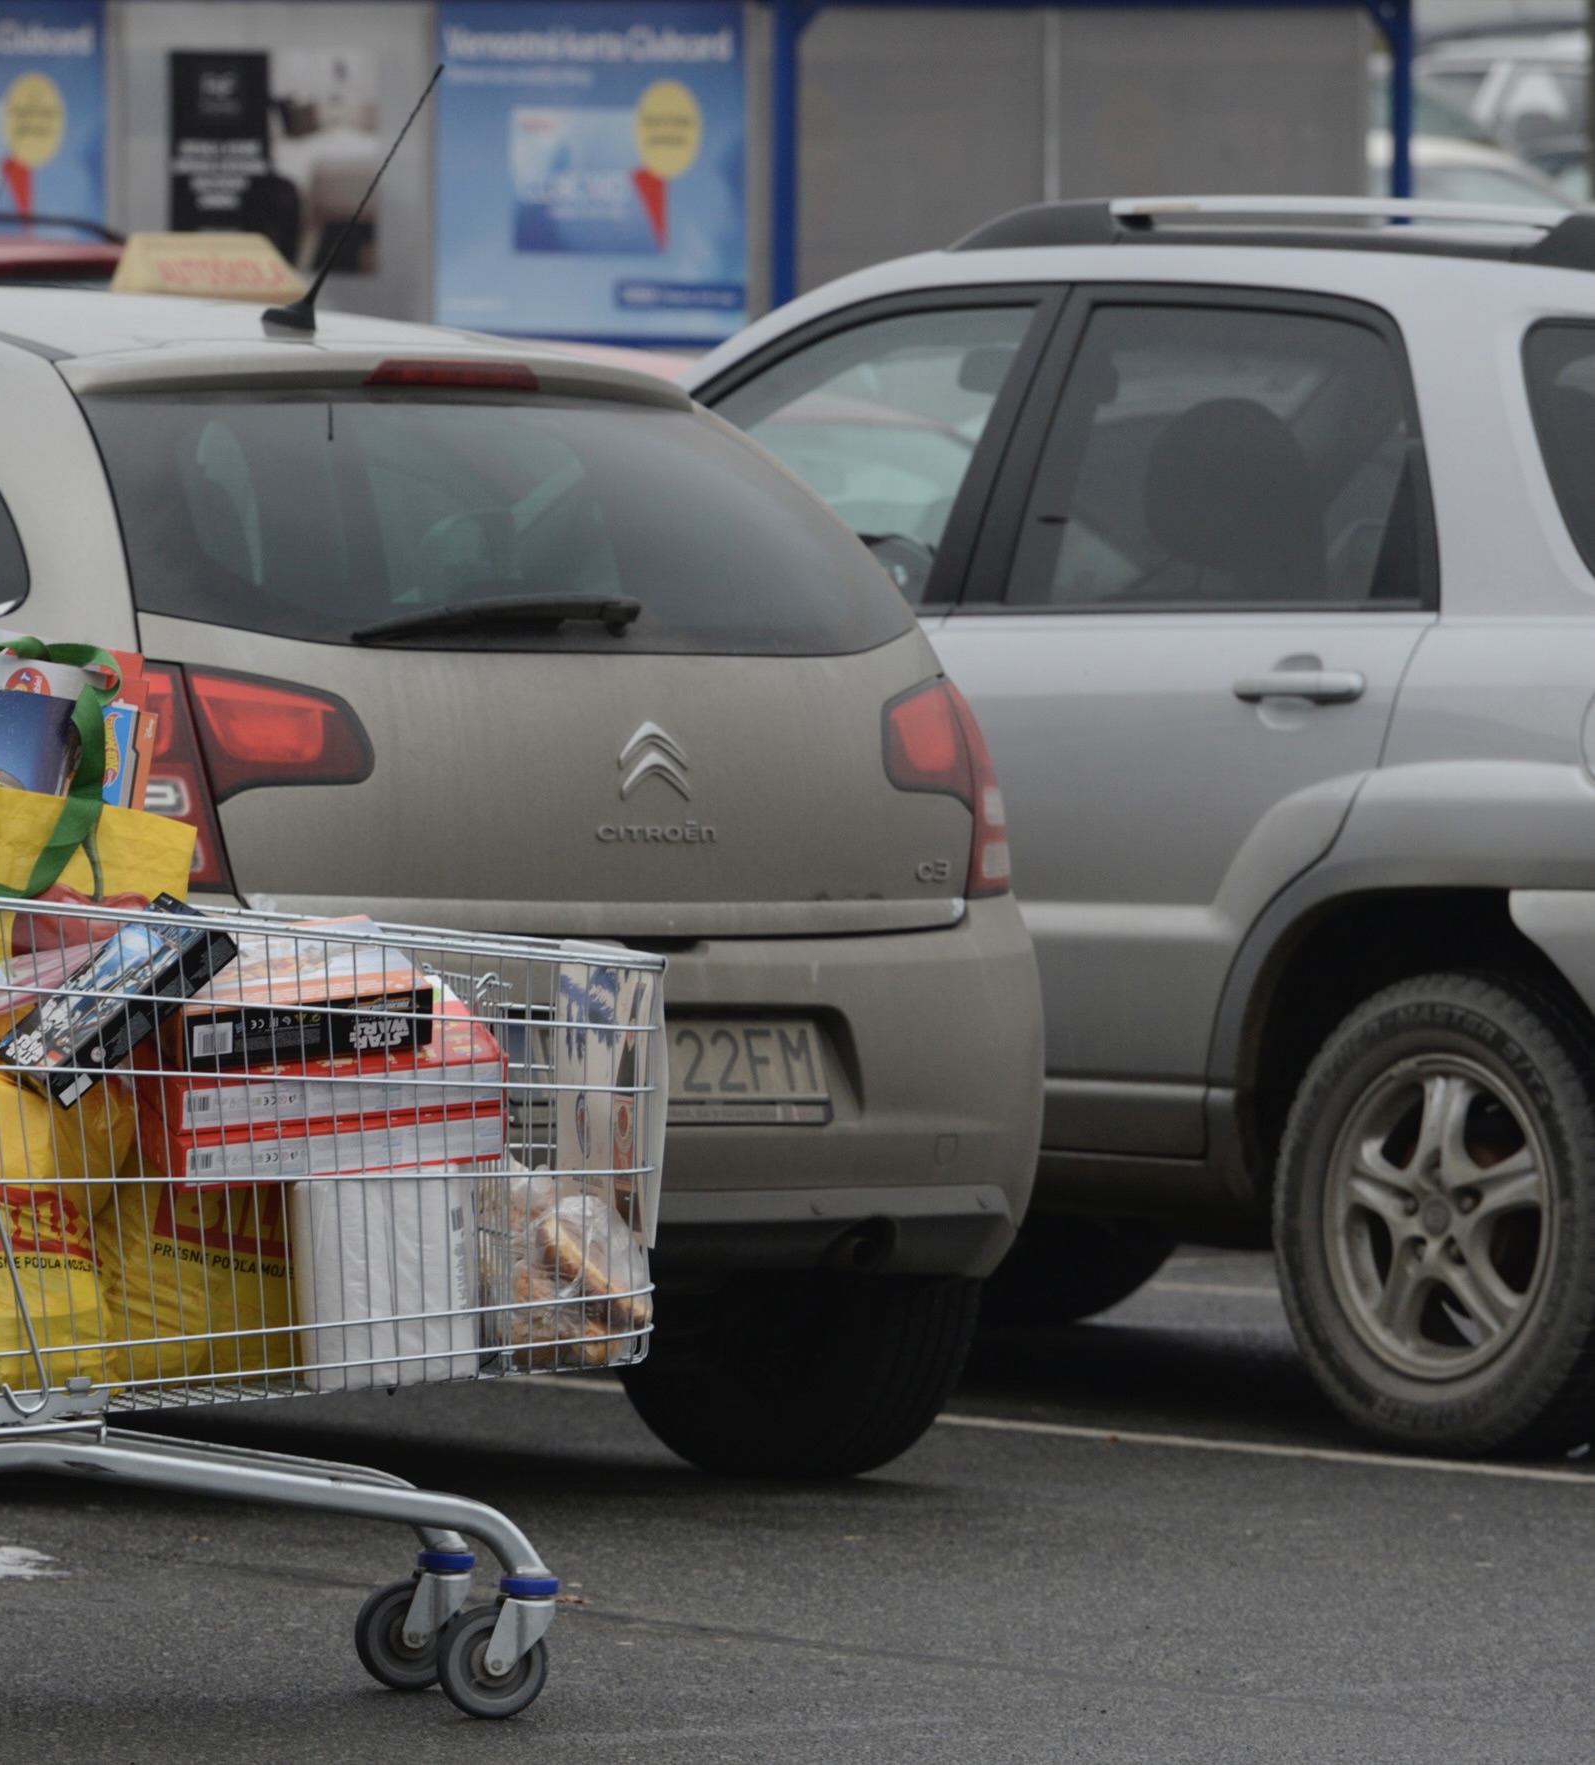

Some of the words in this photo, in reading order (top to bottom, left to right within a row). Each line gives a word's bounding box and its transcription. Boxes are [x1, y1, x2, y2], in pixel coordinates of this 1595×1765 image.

[914, 858, 950, 882] C3
[348, 1031, 410, 1049] STAR
[153, 1242, 210, 1265] PRESNE
